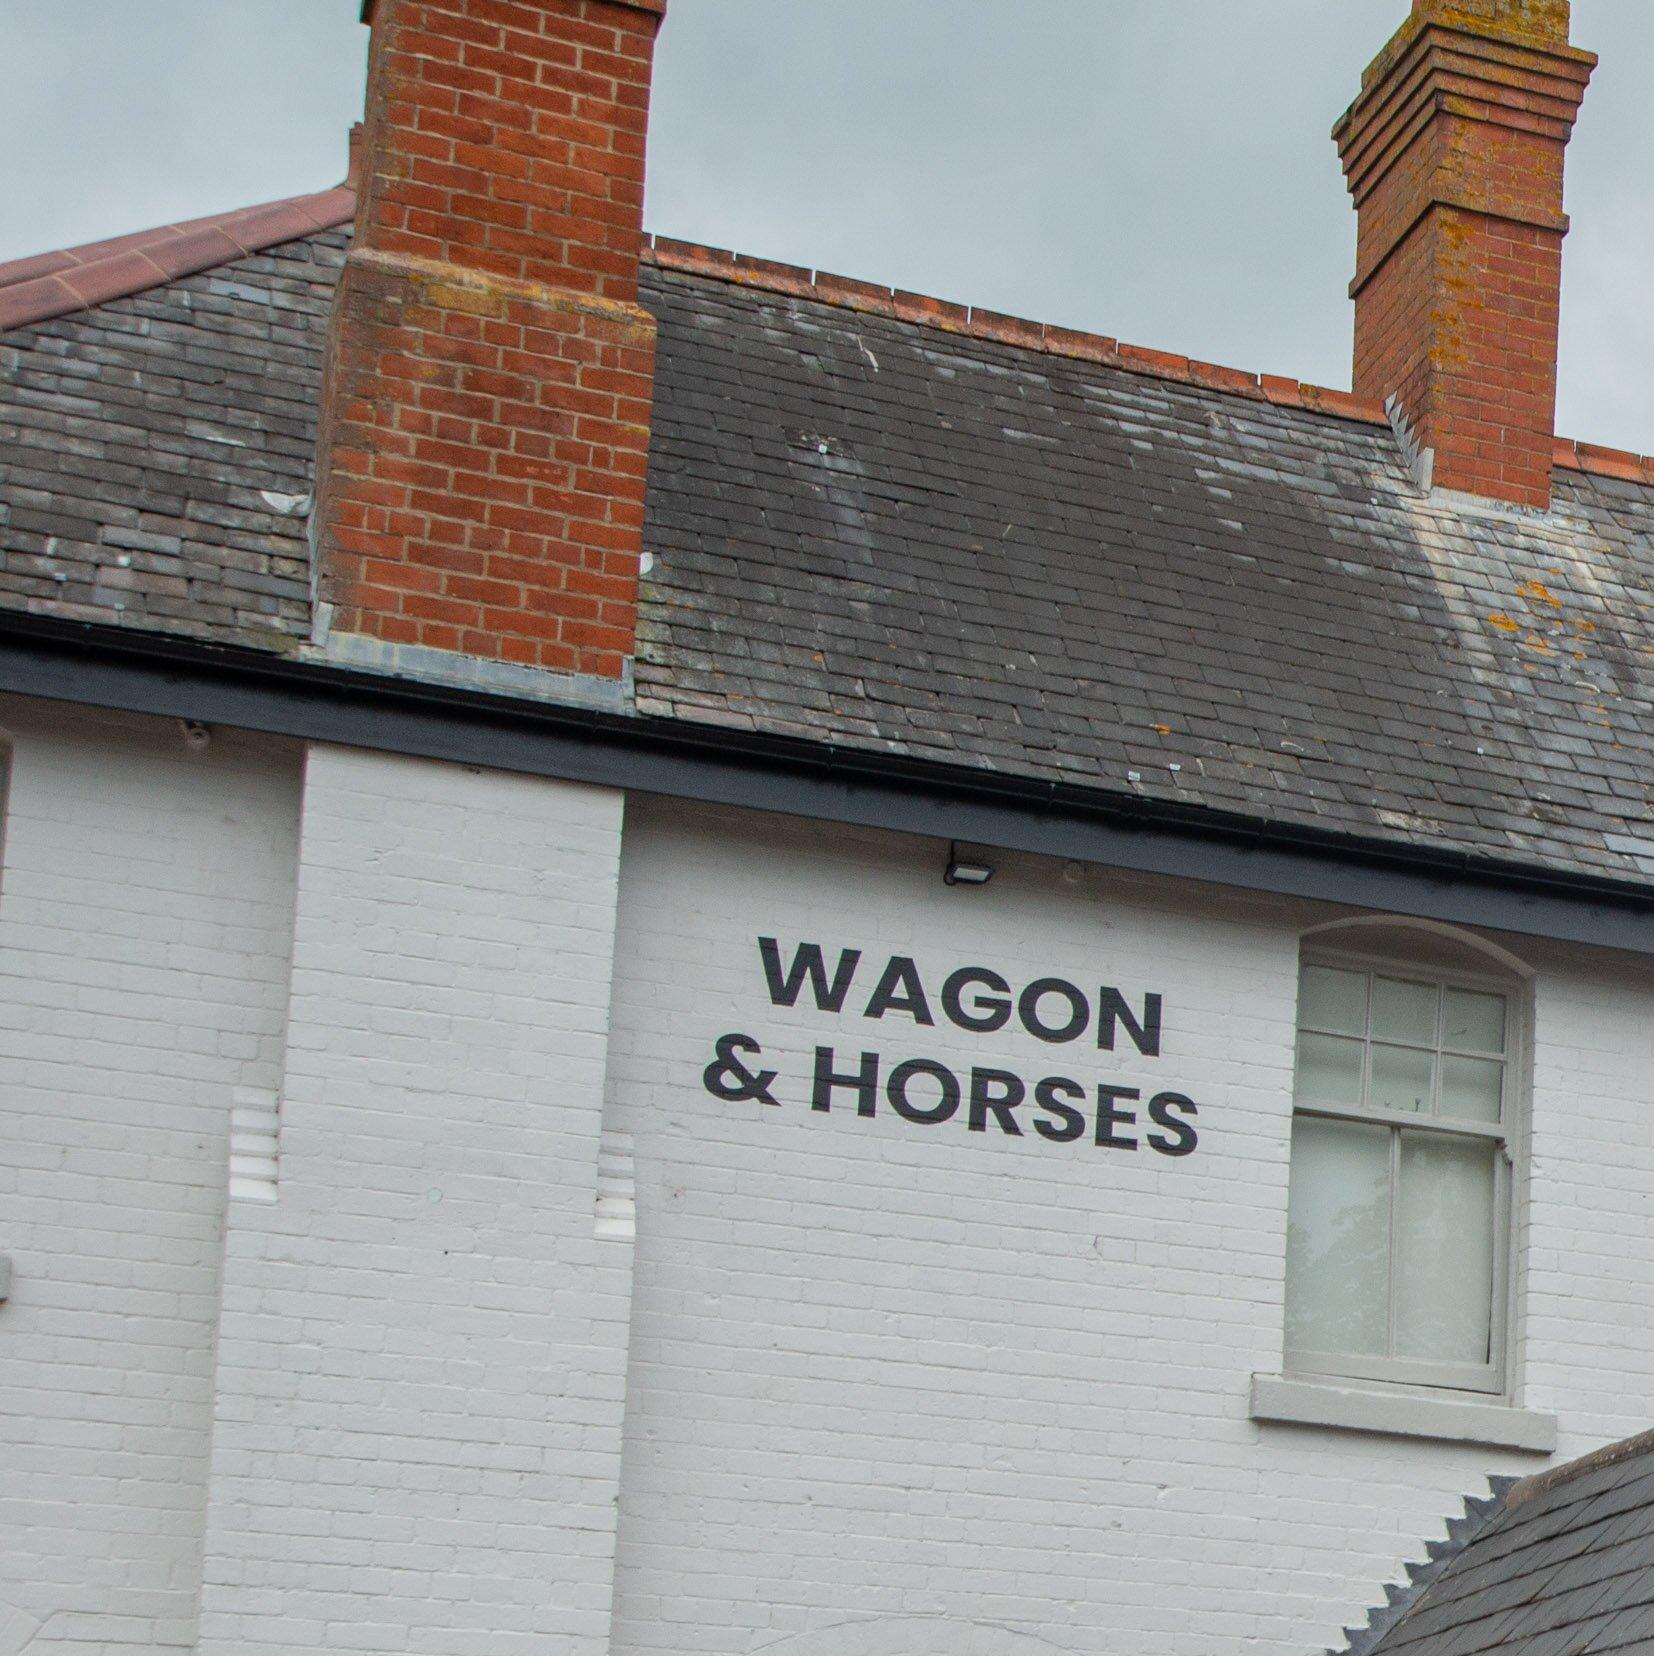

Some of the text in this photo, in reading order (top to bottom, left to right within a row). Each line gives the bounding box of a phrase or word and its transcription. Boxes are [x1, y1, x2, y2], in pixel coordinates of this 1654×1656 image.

[757, 936, 1162, 1058] WAGON
[703, 1033, 1199, 1157] & HORSES
